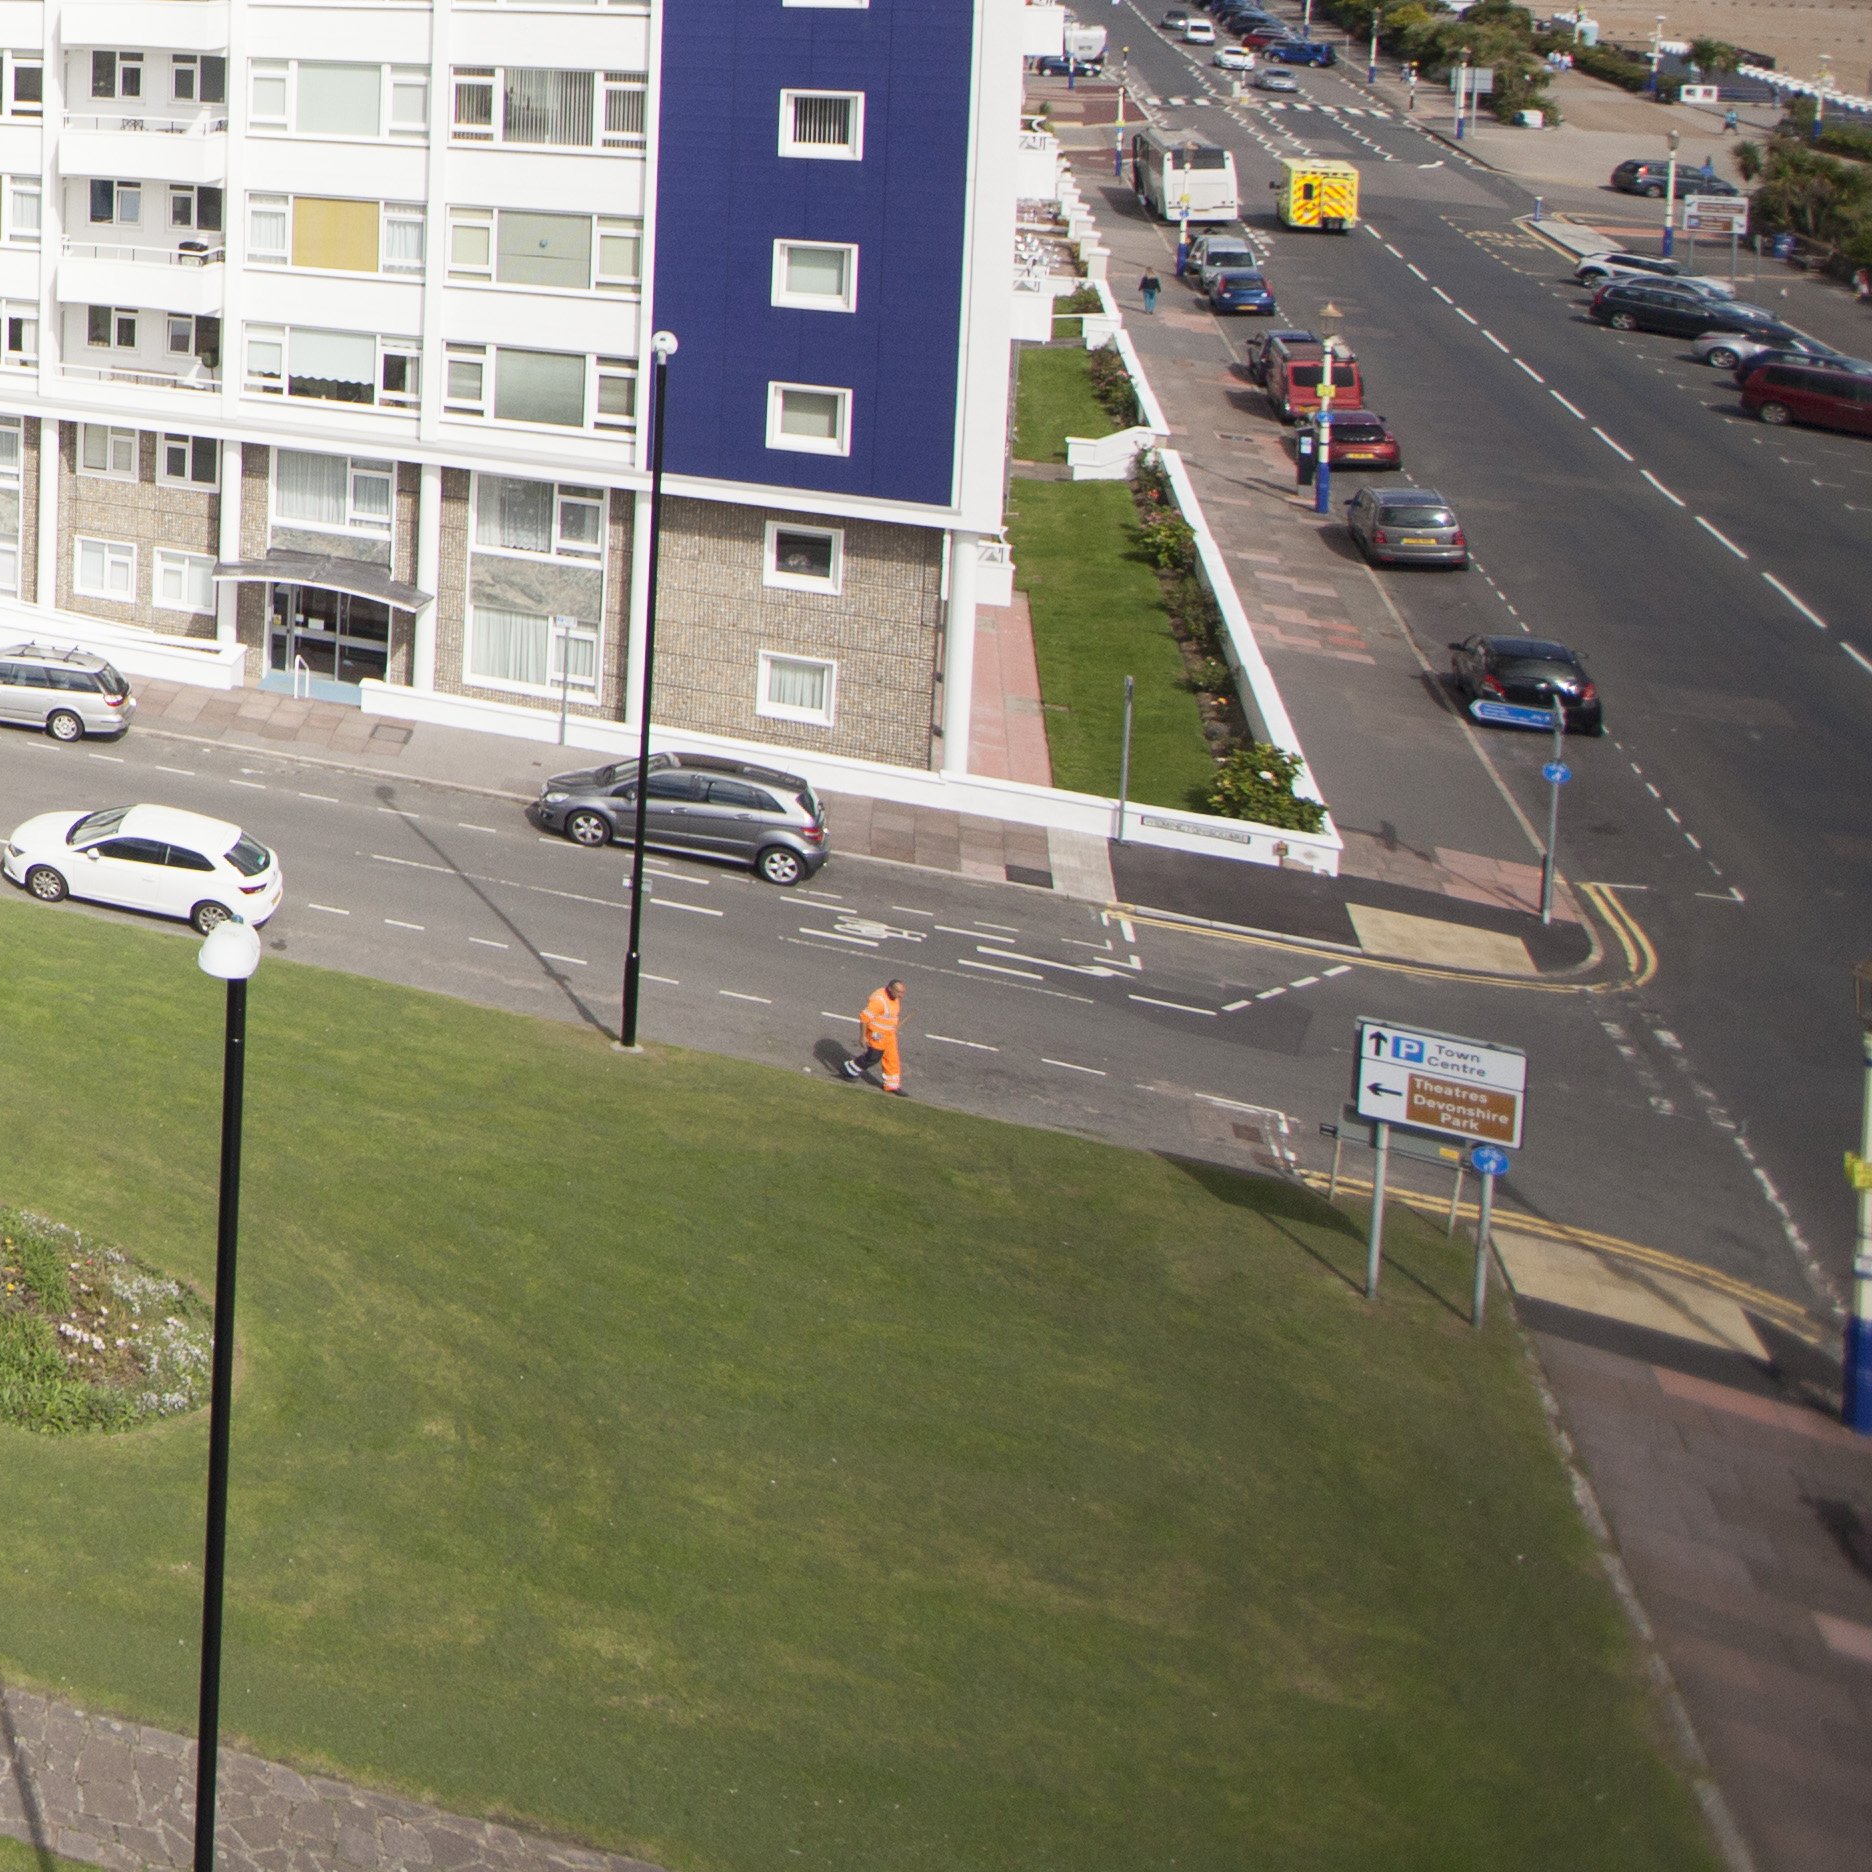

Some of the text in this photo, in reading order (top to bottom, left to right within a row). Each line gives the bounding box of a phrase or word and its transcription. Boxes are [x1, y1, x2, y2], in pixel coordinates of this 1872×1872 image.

[1435, 1044, 1481, 1063] Town
[1427, 1056, 1486, 1077] Centre
[1415, 1079, 1488, 1104] Theatres
[1414, 1095, 1509, 1124] Devonshire
[1440, 1112, 1479, 1131] Park
